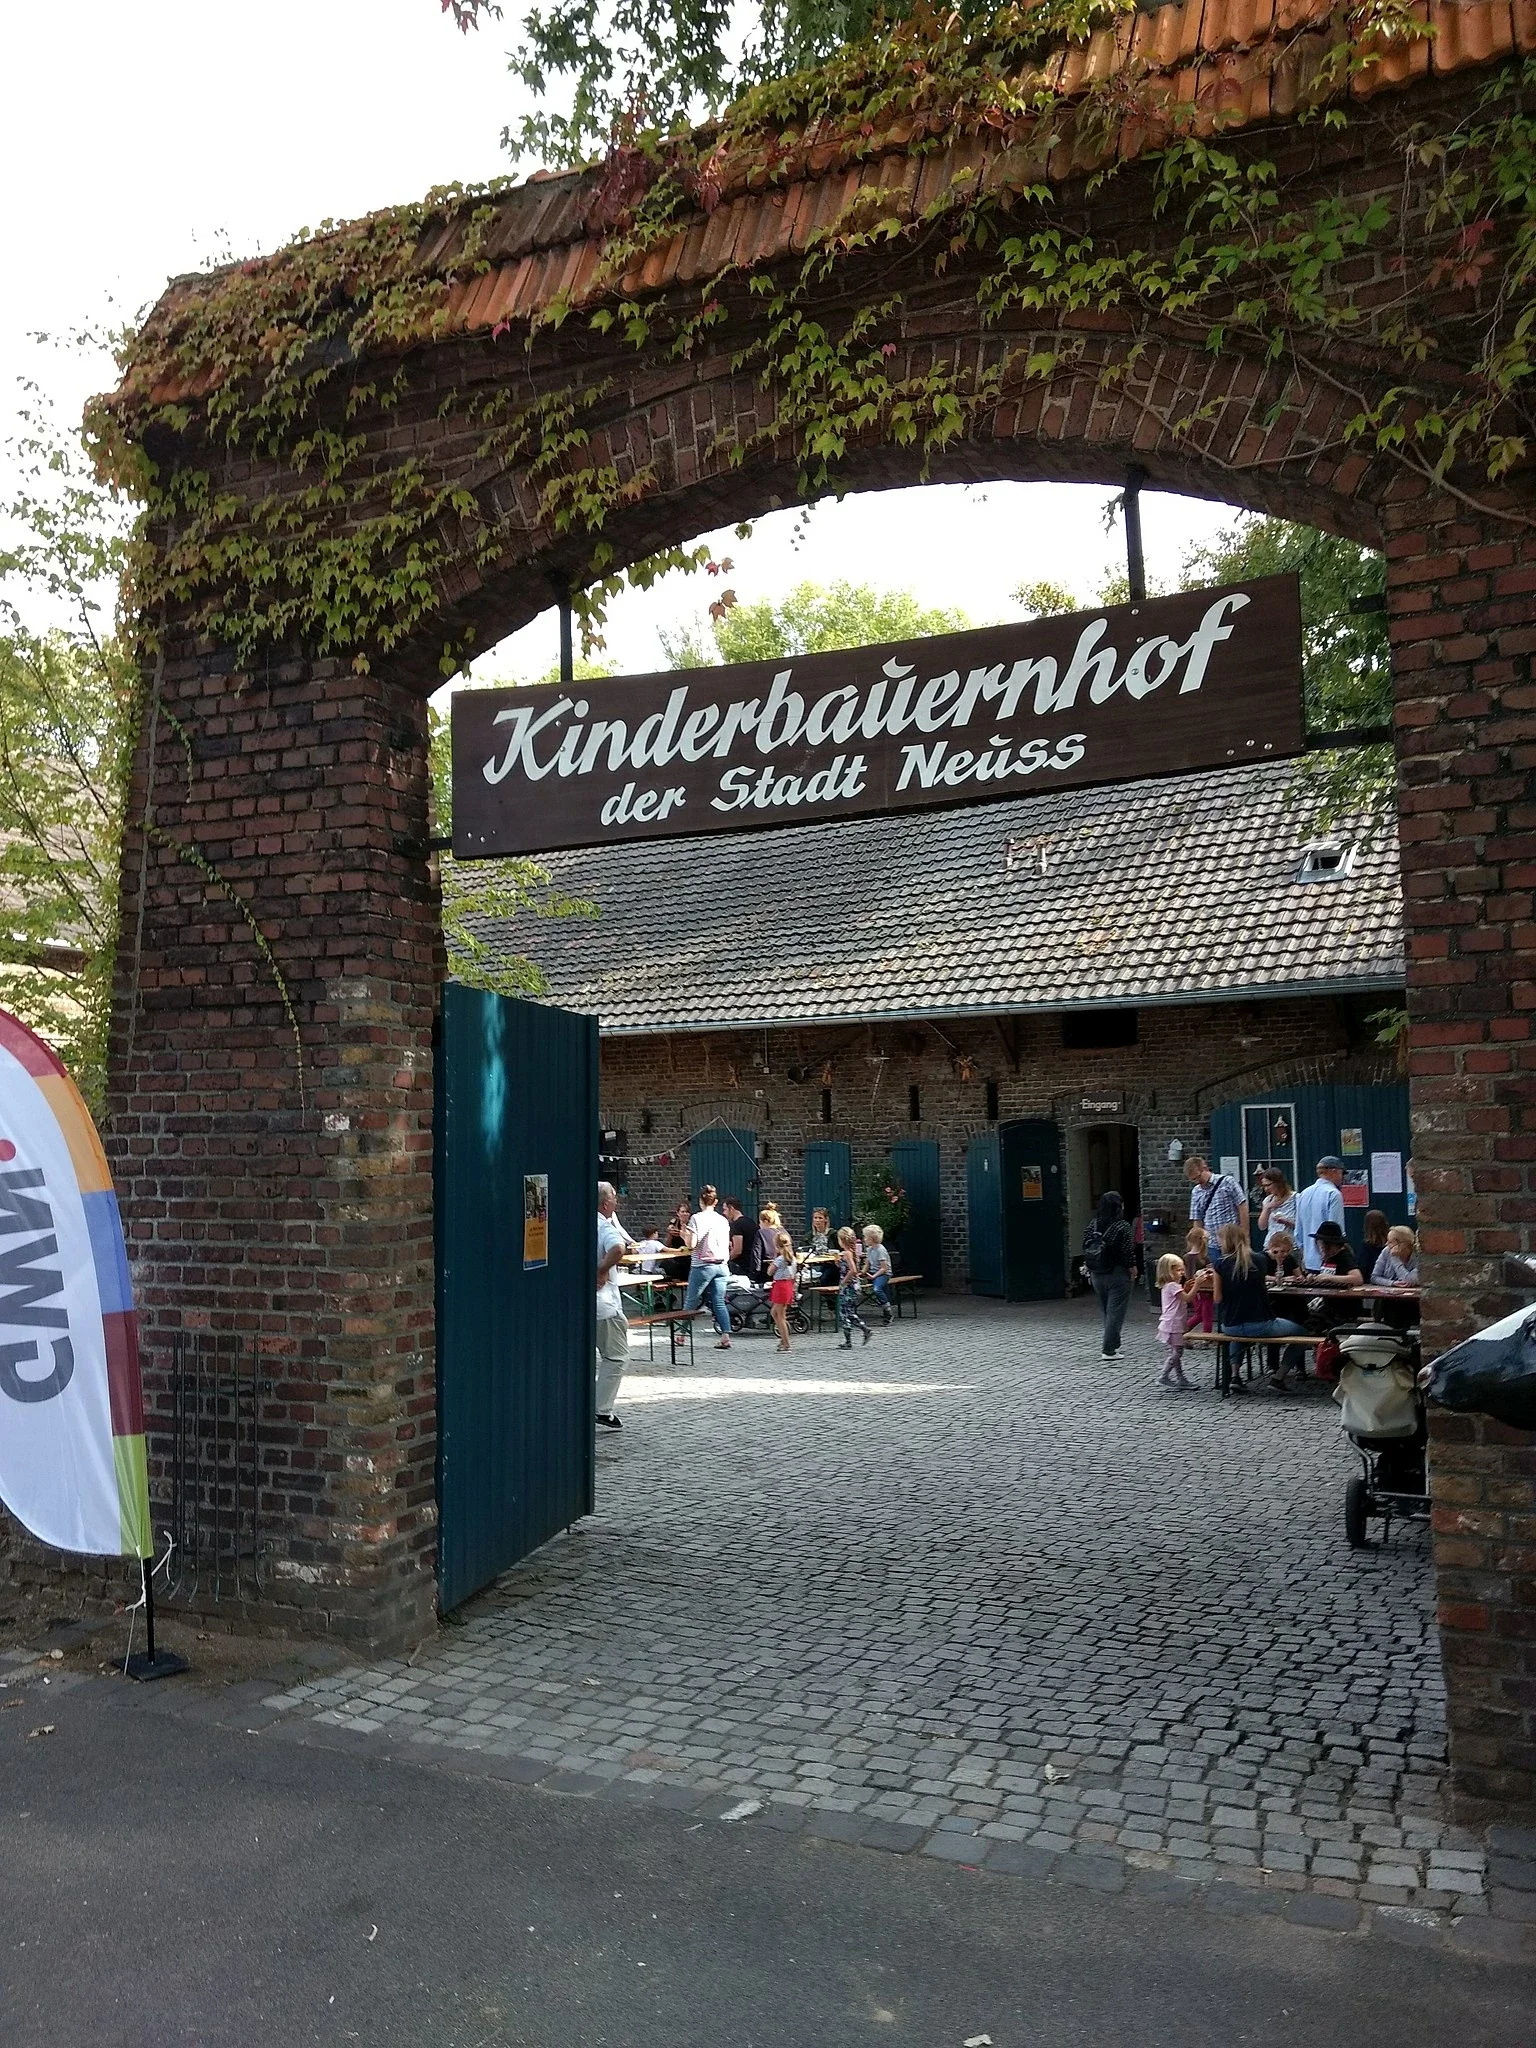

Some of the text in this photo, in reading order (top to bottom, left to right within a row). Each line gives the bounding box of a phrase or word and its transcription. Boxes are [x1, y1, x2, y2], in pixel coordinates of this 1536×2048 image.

[600, 781, 687, 826] der
[709, 754, 868, 812] Stadt
[1082, 1098, 1118, 1112] Eingang
